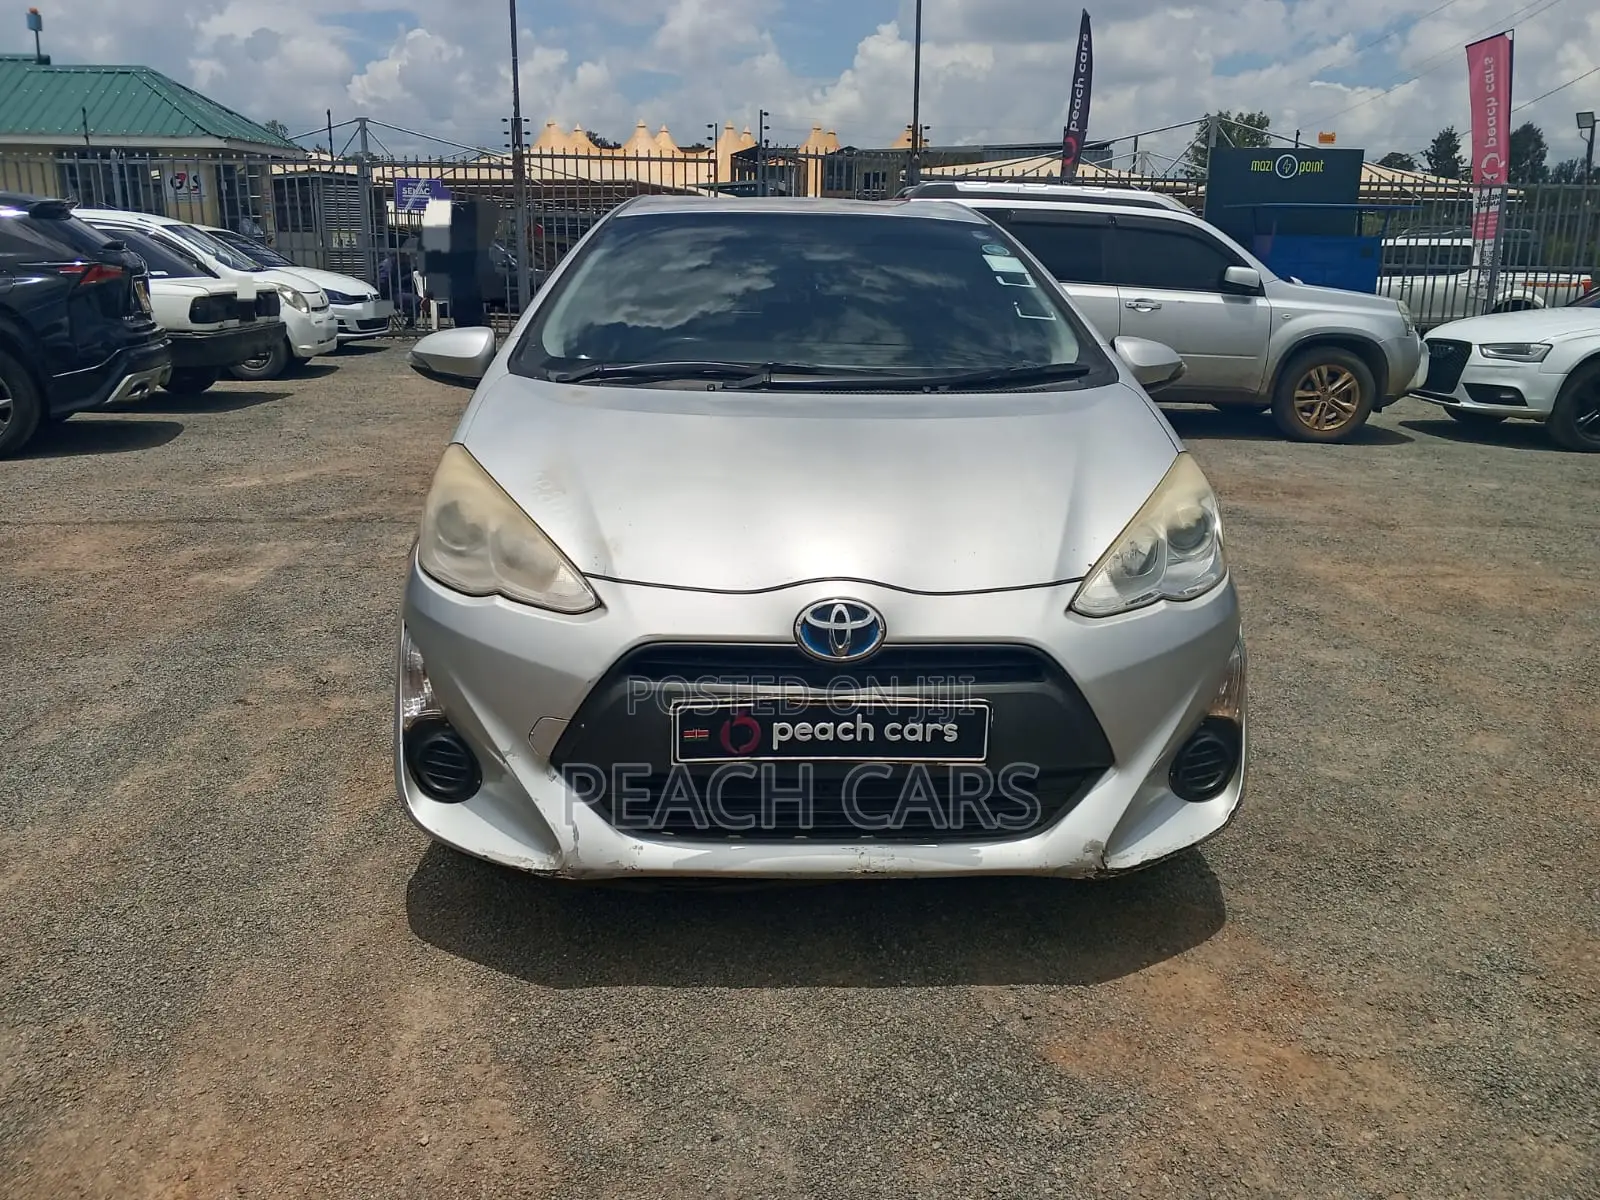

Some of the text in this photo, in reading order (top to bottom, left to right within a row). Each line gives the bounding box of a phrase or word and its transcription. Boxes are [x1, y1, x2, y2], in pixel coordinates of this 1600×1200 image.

[1069, 33, 1089, 132] peach cars
[1298, 159, 1325, 176] point
[772, 713, 959, 751] peach cars
